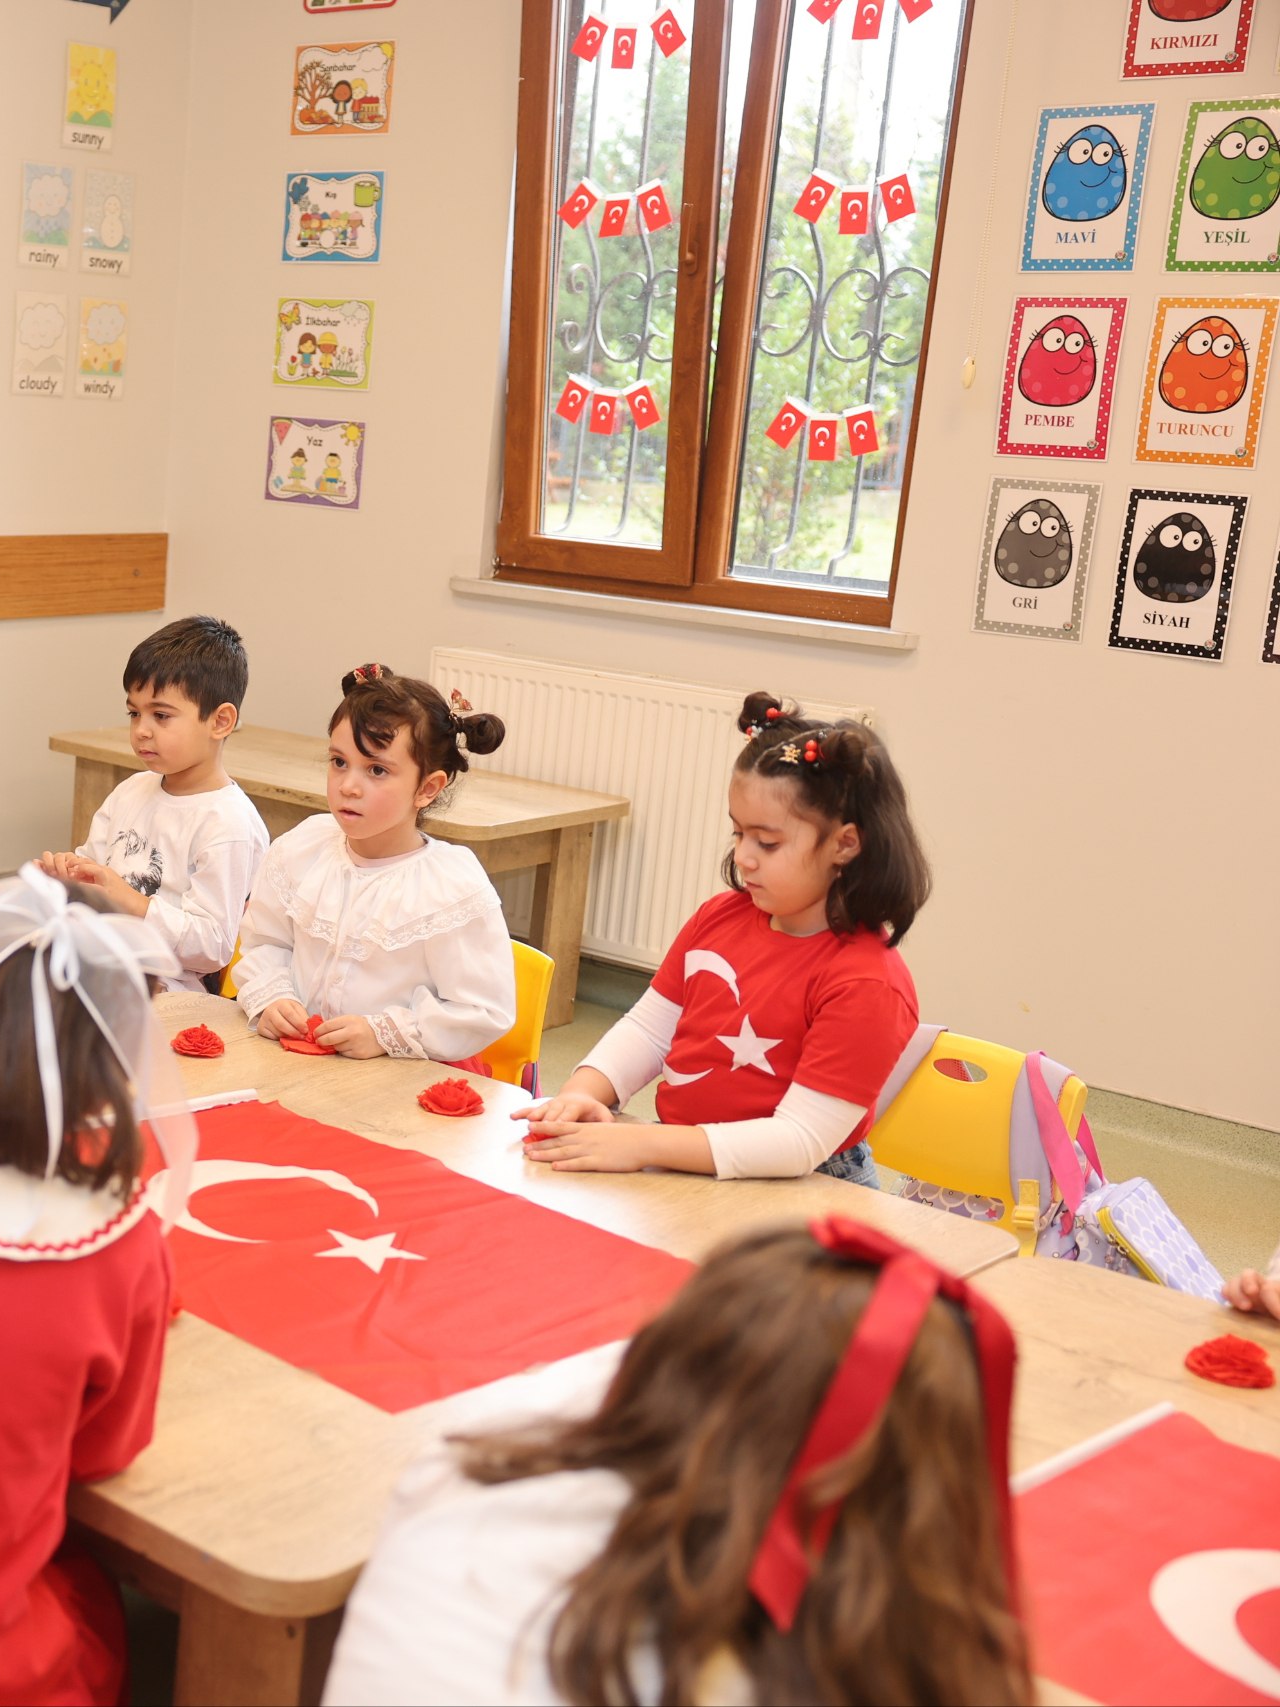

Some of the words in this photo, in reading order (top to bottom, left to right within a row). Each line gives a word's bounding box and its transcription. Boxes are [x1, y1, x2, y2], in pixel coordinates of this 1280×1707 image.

[1150, 33, 1220, 50] KIRMIZI
[71, 132, 105, 150] sunny
[1055, 228, 1097, 244] MAVİ
[1203, 228, 1252, 246] YEŞİL
[28, 248, 60, 269] rainy
[88, 257, 124, 274] snowy
[18, 375, 58, 395] cloudy
[83, 380, 116, 399] windy
[1023, 414, 1076, 428] PEMBE
[1156, 422, 1235, 438] TURUNCU
[306, 435, 324, 447] Yaz
[1011, 596, 1039, 610] GRİ
[1142, 610, 1192, 629] SİYAH
